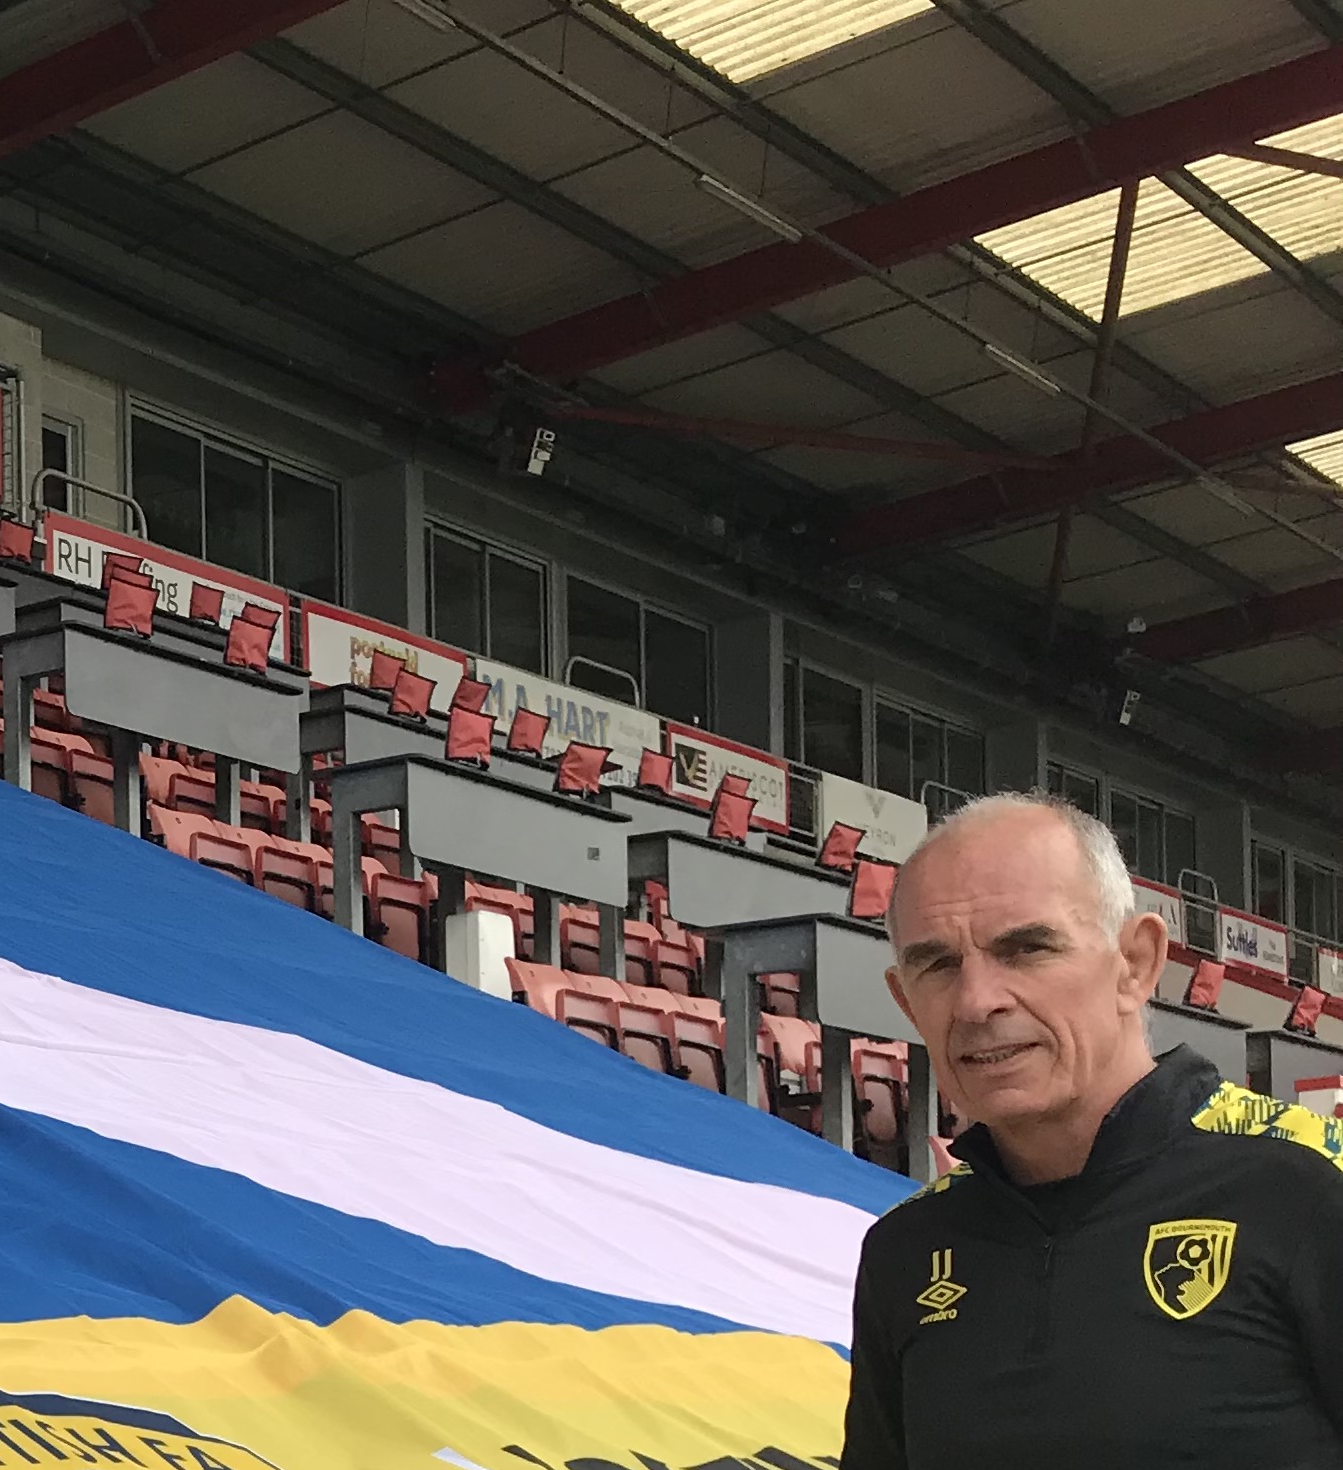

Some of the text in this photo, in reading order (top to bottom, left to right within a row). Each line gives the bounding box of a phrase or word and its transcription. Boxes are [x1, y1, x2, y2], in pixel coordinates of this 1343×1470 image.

[58, 537, 92, 579] RH
[545, 694, 609, 745] HART
[930, 1248, 953, 1282] JJ
